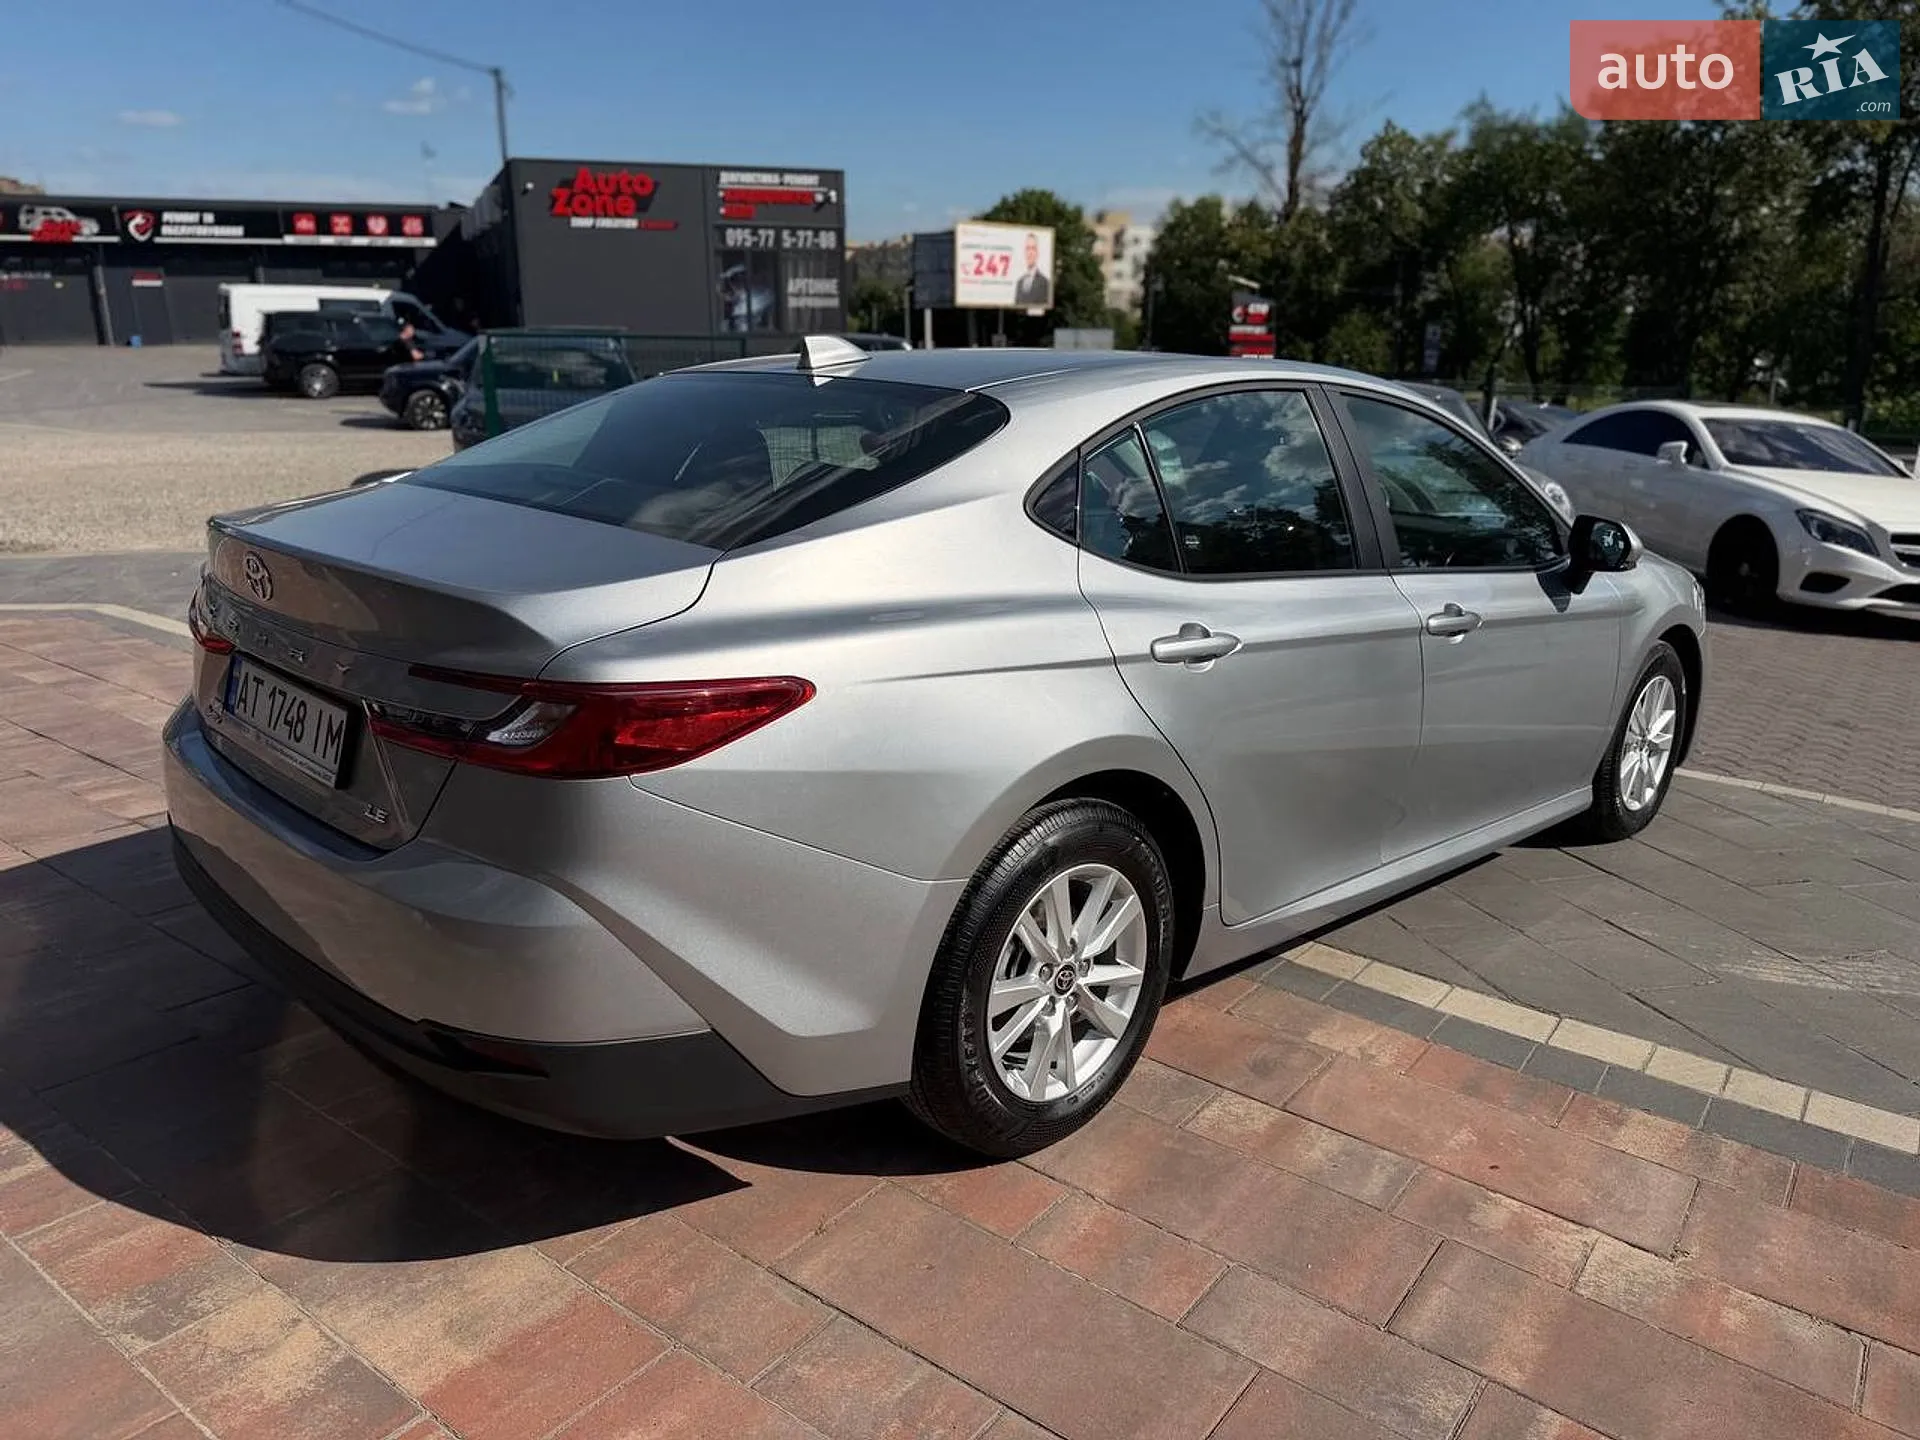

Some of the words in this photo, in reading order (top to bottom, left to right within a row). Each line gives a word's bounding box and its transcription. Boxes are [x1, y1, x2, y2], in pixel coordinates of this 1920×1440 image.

[575, 167, 654, 196] Auto
[551, 187, 638, 217] Zone
[973, 252, 1011, 277] 247
[236, 671, 264, 719] AT
[268, 686, 307, 743] 1748
[313, 709, 345, 765] IM
[364, 802, 389, 825] LE
